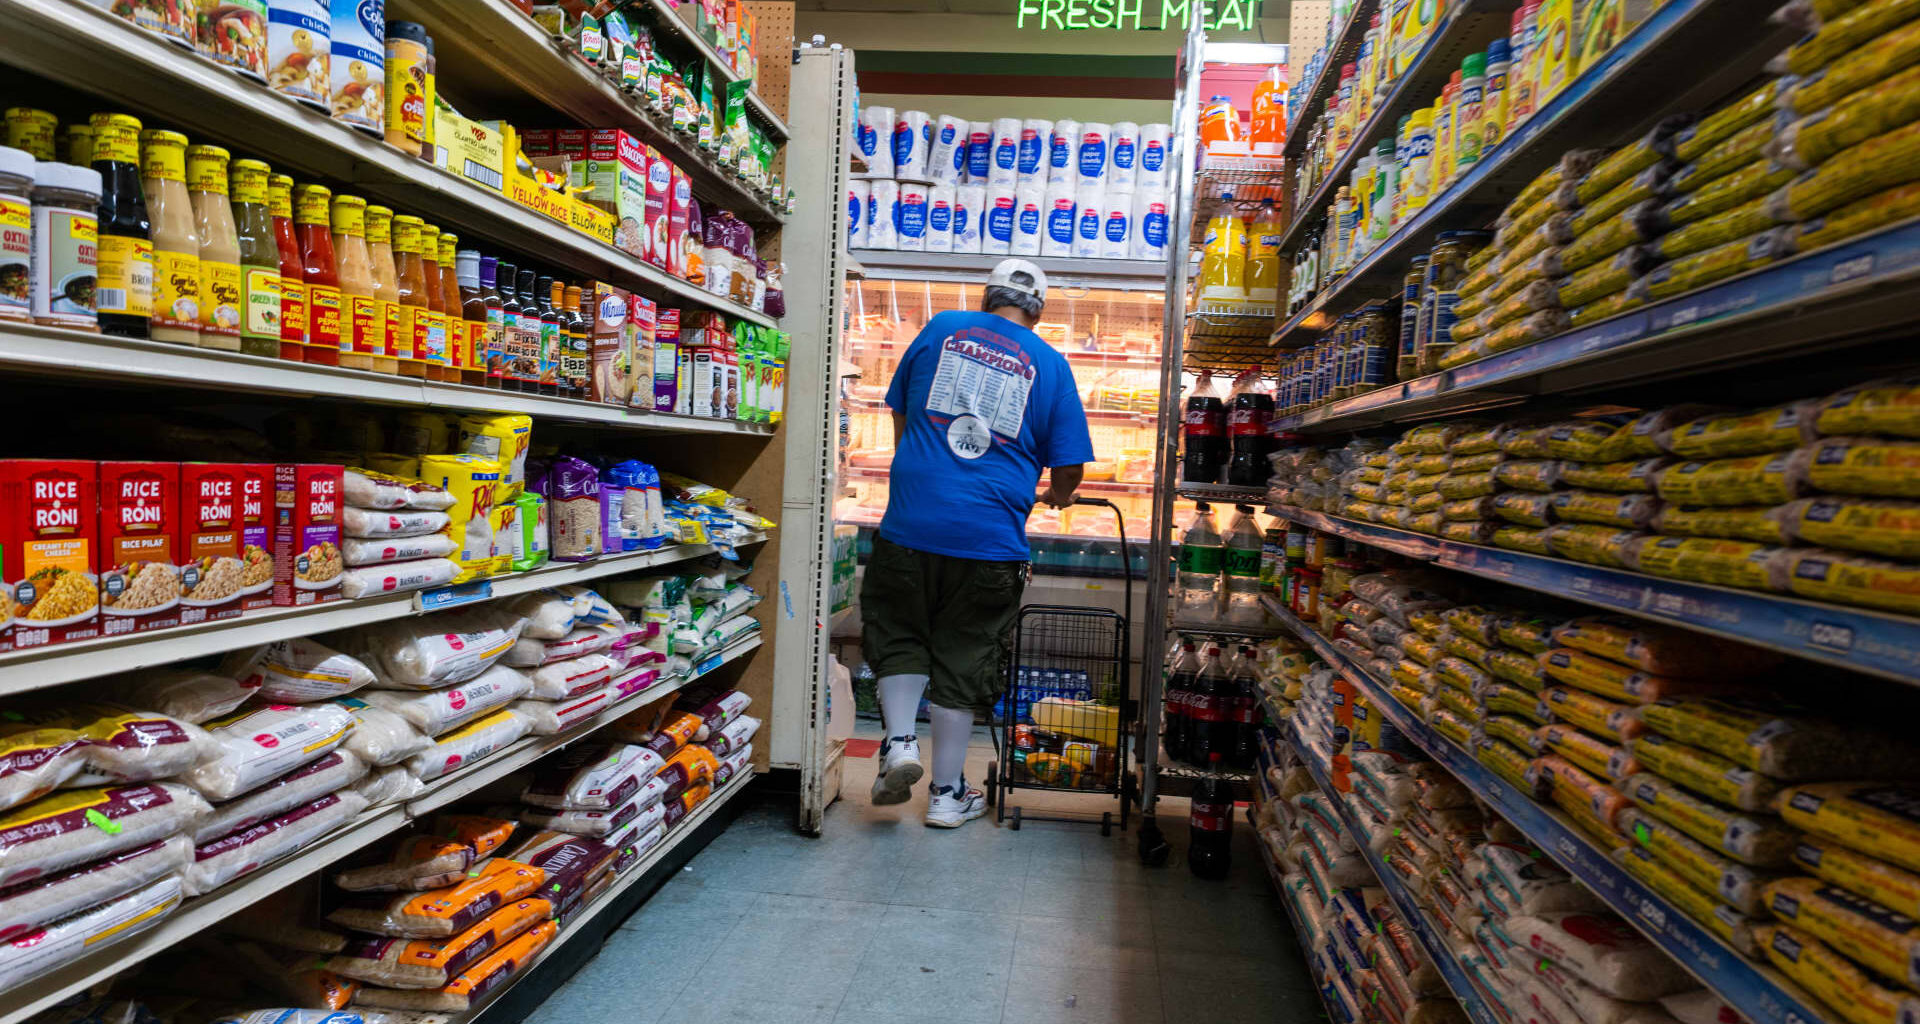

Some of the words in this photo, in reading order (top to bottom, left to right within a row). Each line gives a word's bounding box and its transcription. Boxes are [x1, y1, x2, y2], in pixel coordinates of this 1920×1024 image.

[1017, 0, 1142, 29] FRESH
[620, 137, 646, 169] Success
[511, 185, 550, 211] YELLOW
[551, 201, 568, 220] RICE
[597, 224, 612, 241] RICE
[945, 339, 1033, 381] CHAMPIONS
[35, 481, 77, 499] RICE
[122, 481, 160, 498] RICE
[200, 481, 232, 497] RICE
[311, 481, 335, 494] RICE
[36, 508, 78, 526] RONI
[122, 504, 160, 523] RONI
[200, 503, 232, 519] RONI
[311, 501, 335, 516] RONI
[122, 539, 141, 549] RICE
[142, 538, 164, 548] PILAF
[198, 535, 215, 545] RICE
[216, 534, 233, 544] PILAF
